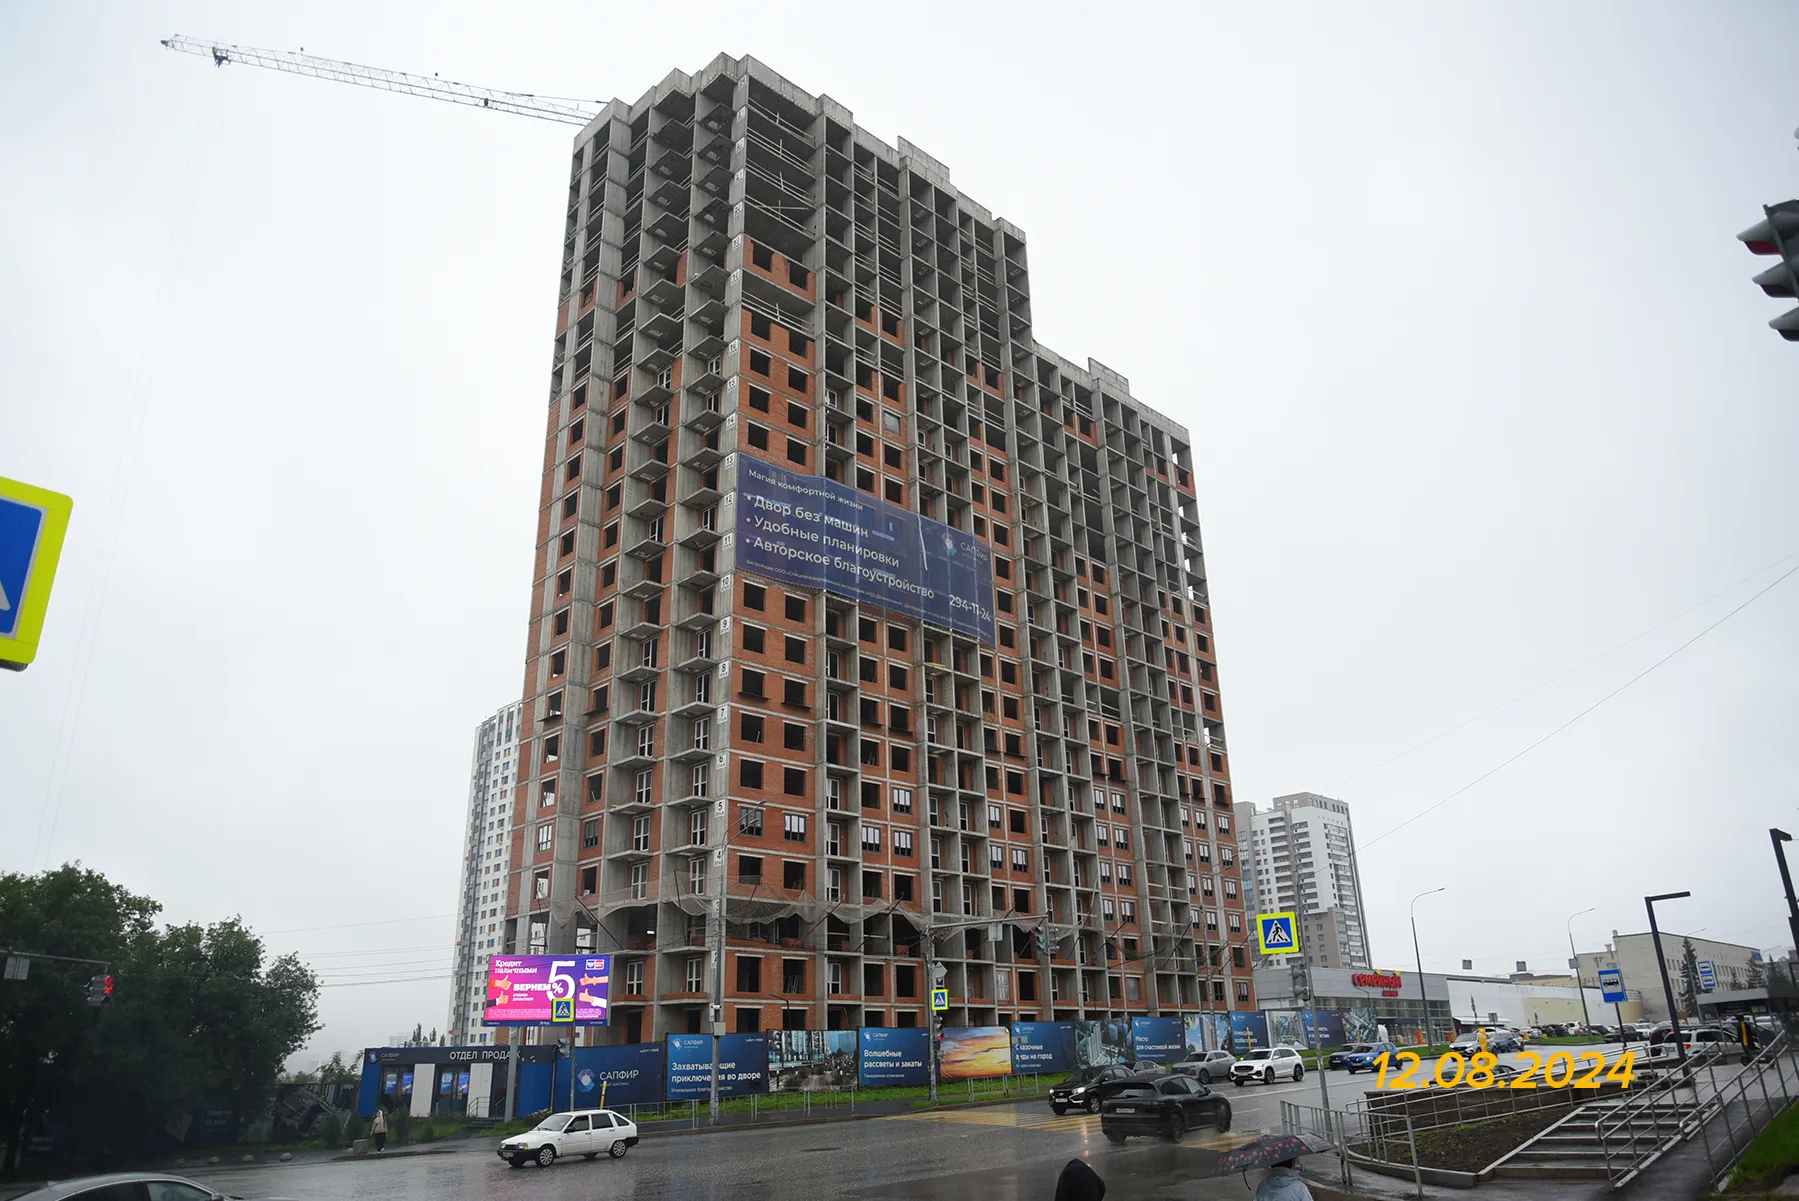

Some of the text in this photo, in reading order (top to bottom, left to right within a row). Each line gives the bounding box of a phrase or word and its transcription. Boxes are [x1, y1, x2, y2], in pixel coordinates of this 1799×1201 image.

[726, 456, 734, 466] 13
[748, 468, 864, 511] Магия комфортной жизни
[725, 494, 733, 504] 12
[754, 495, 868, 538] Двор без машин
[723, 535, 731, 545] 11
[754, 515, 900, 568] Удобные планировки
[753, 537, 935, 599] Авторское благоустройство
[721, 576, 730, 586] 10
[948, 594, 992, 622] 294-11-24
[722, 619, 728, 628] 9
[721, 663, 726, 672] 8
[720, 707, 725, 717] 7
[719, 755, 724, 763] 6
[717, 801, 723, 811] 5
[716, 849, 721, 859] 4
[495, 960, 522, 968] Кредит
[513, 983, 552, 991] ВЕРНЕМ
[449, 1051, 478, 1060] ОТДЕЛ
[864, 1049, 902, 1057] Волшебные
[671, 1062, 736, 1071] Захватыващие
[600, 1069, 639, 1080] САПФИР
[671, 1073, 726, 1083] приключея
[737, 1072, 761, 1081] дворе
